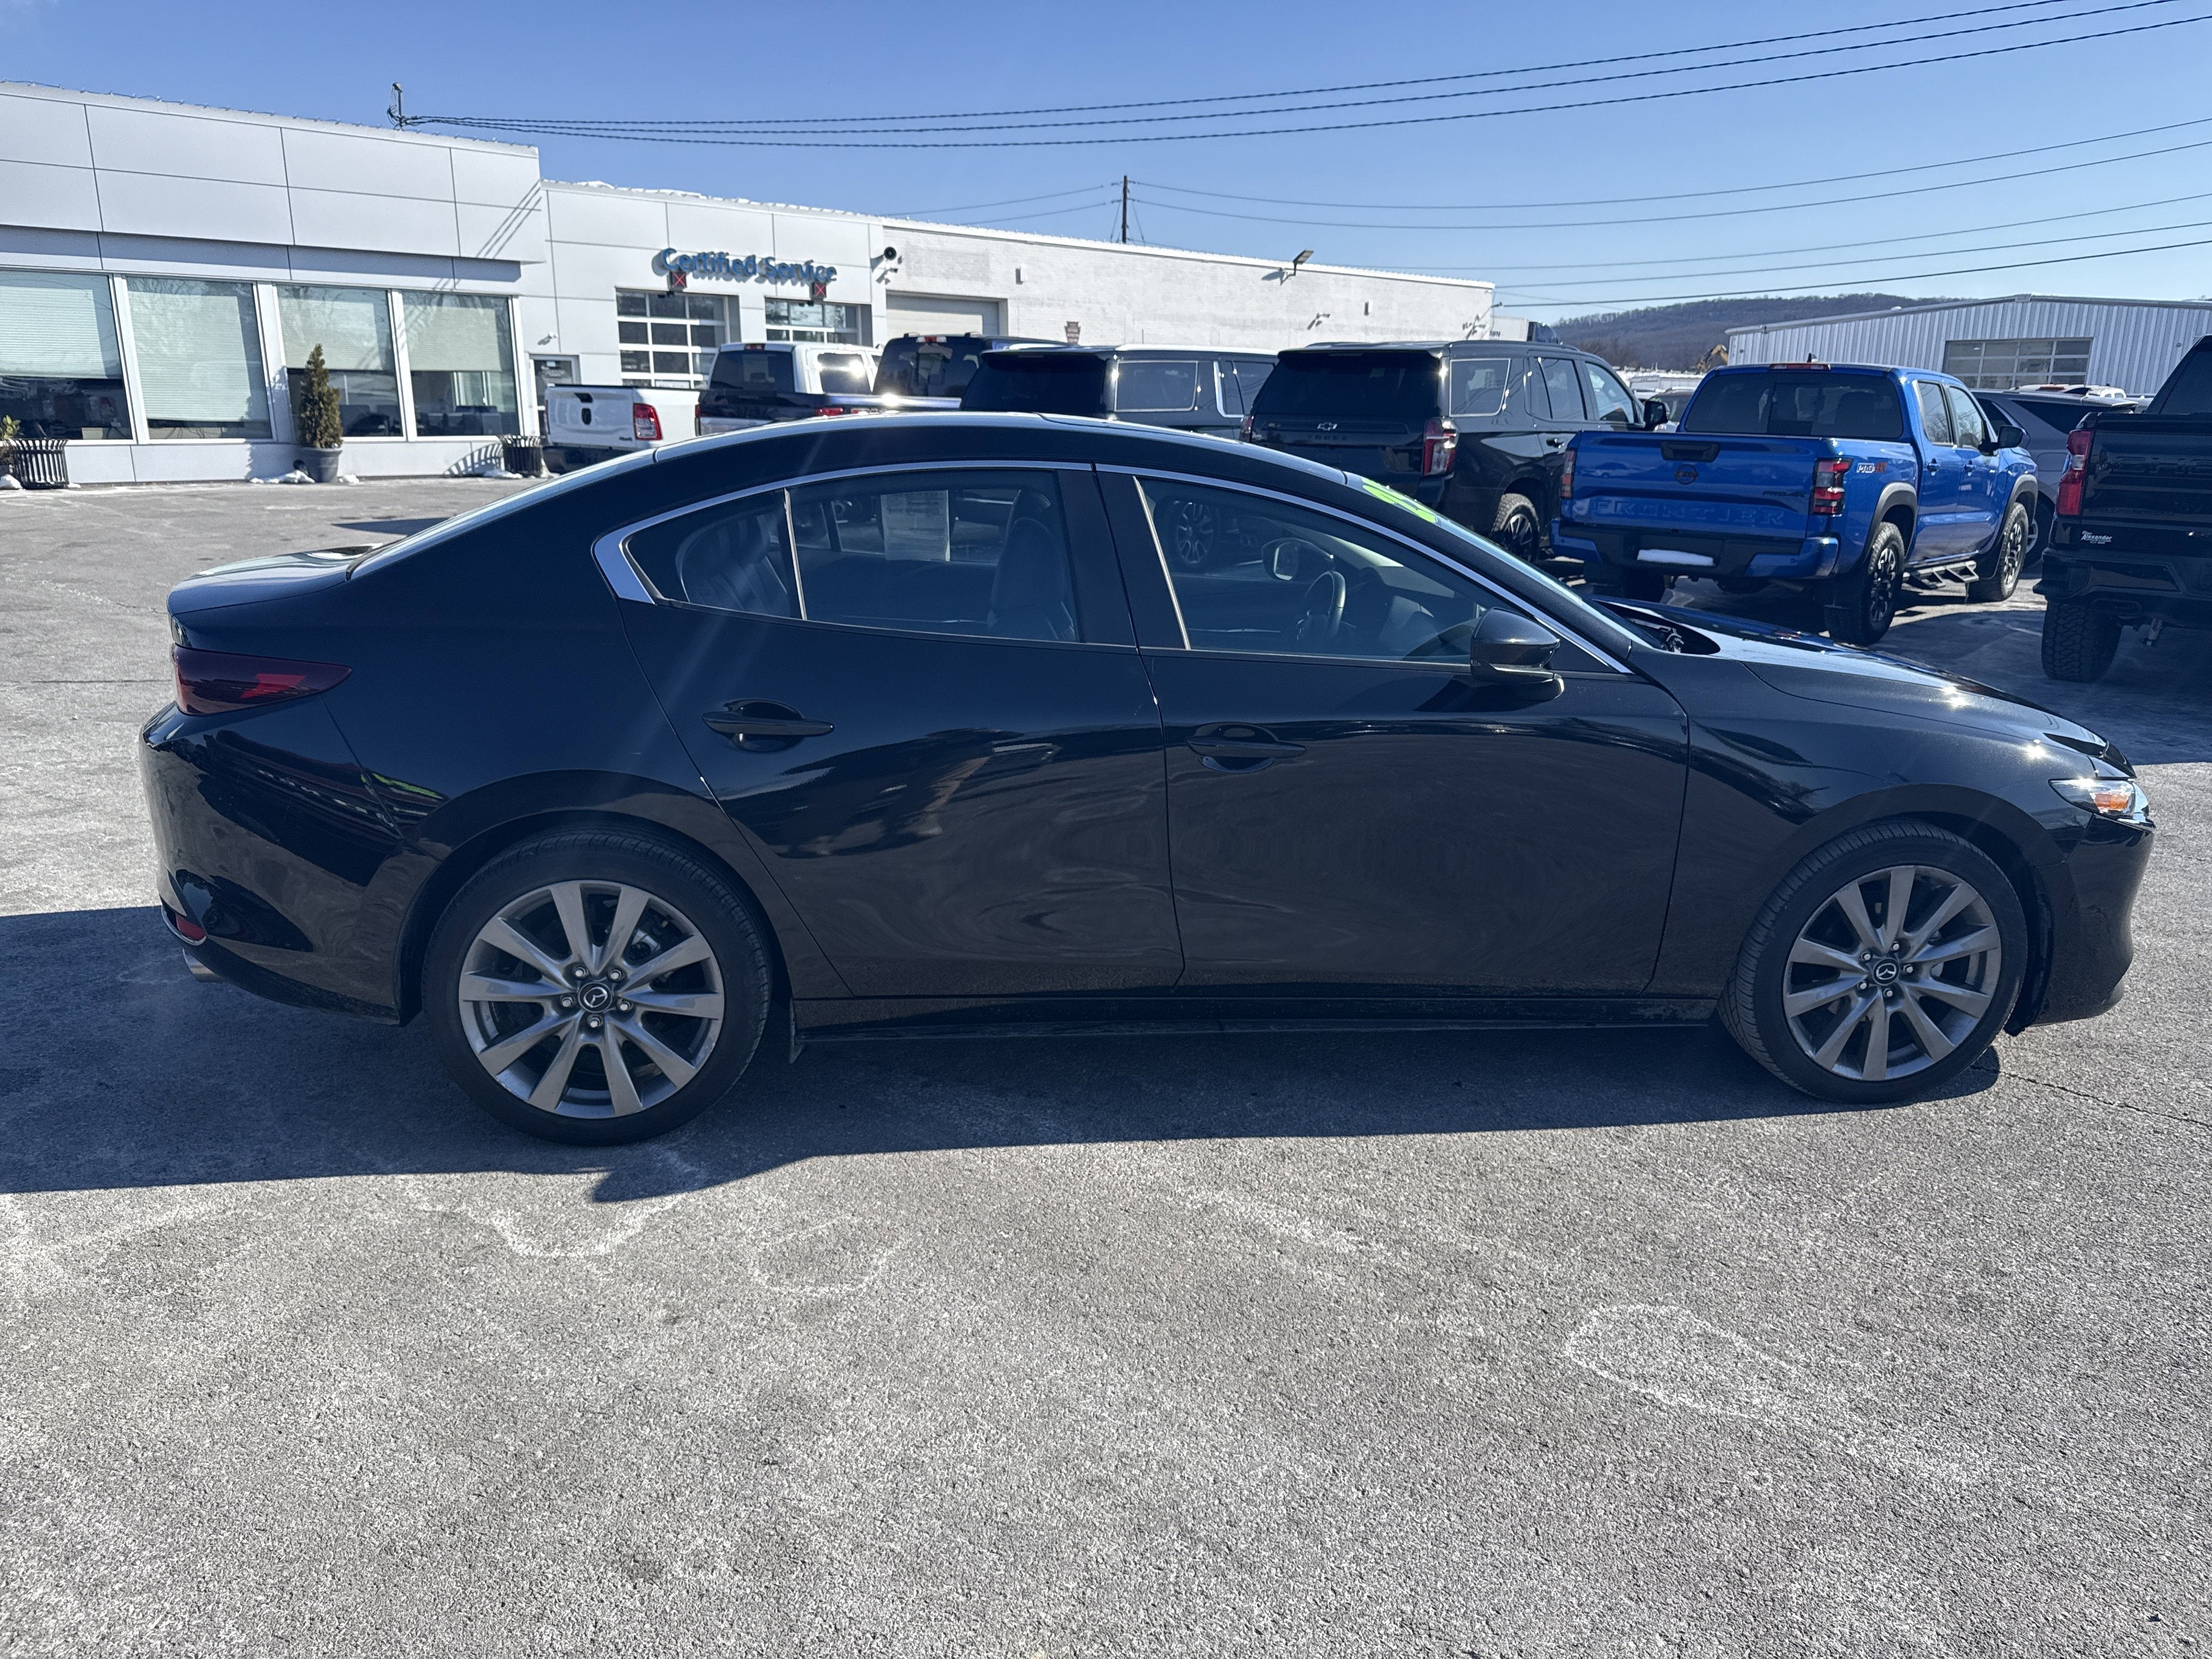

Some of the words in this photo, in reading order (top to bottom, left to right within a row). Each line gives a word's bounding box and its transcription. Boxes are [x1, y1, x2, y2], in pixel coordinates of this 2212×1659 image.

[662, 247, 757, 276] Certified
[764, 256, 837, 282] Service
[1593, 499, 1784, 526] FRONTIER
